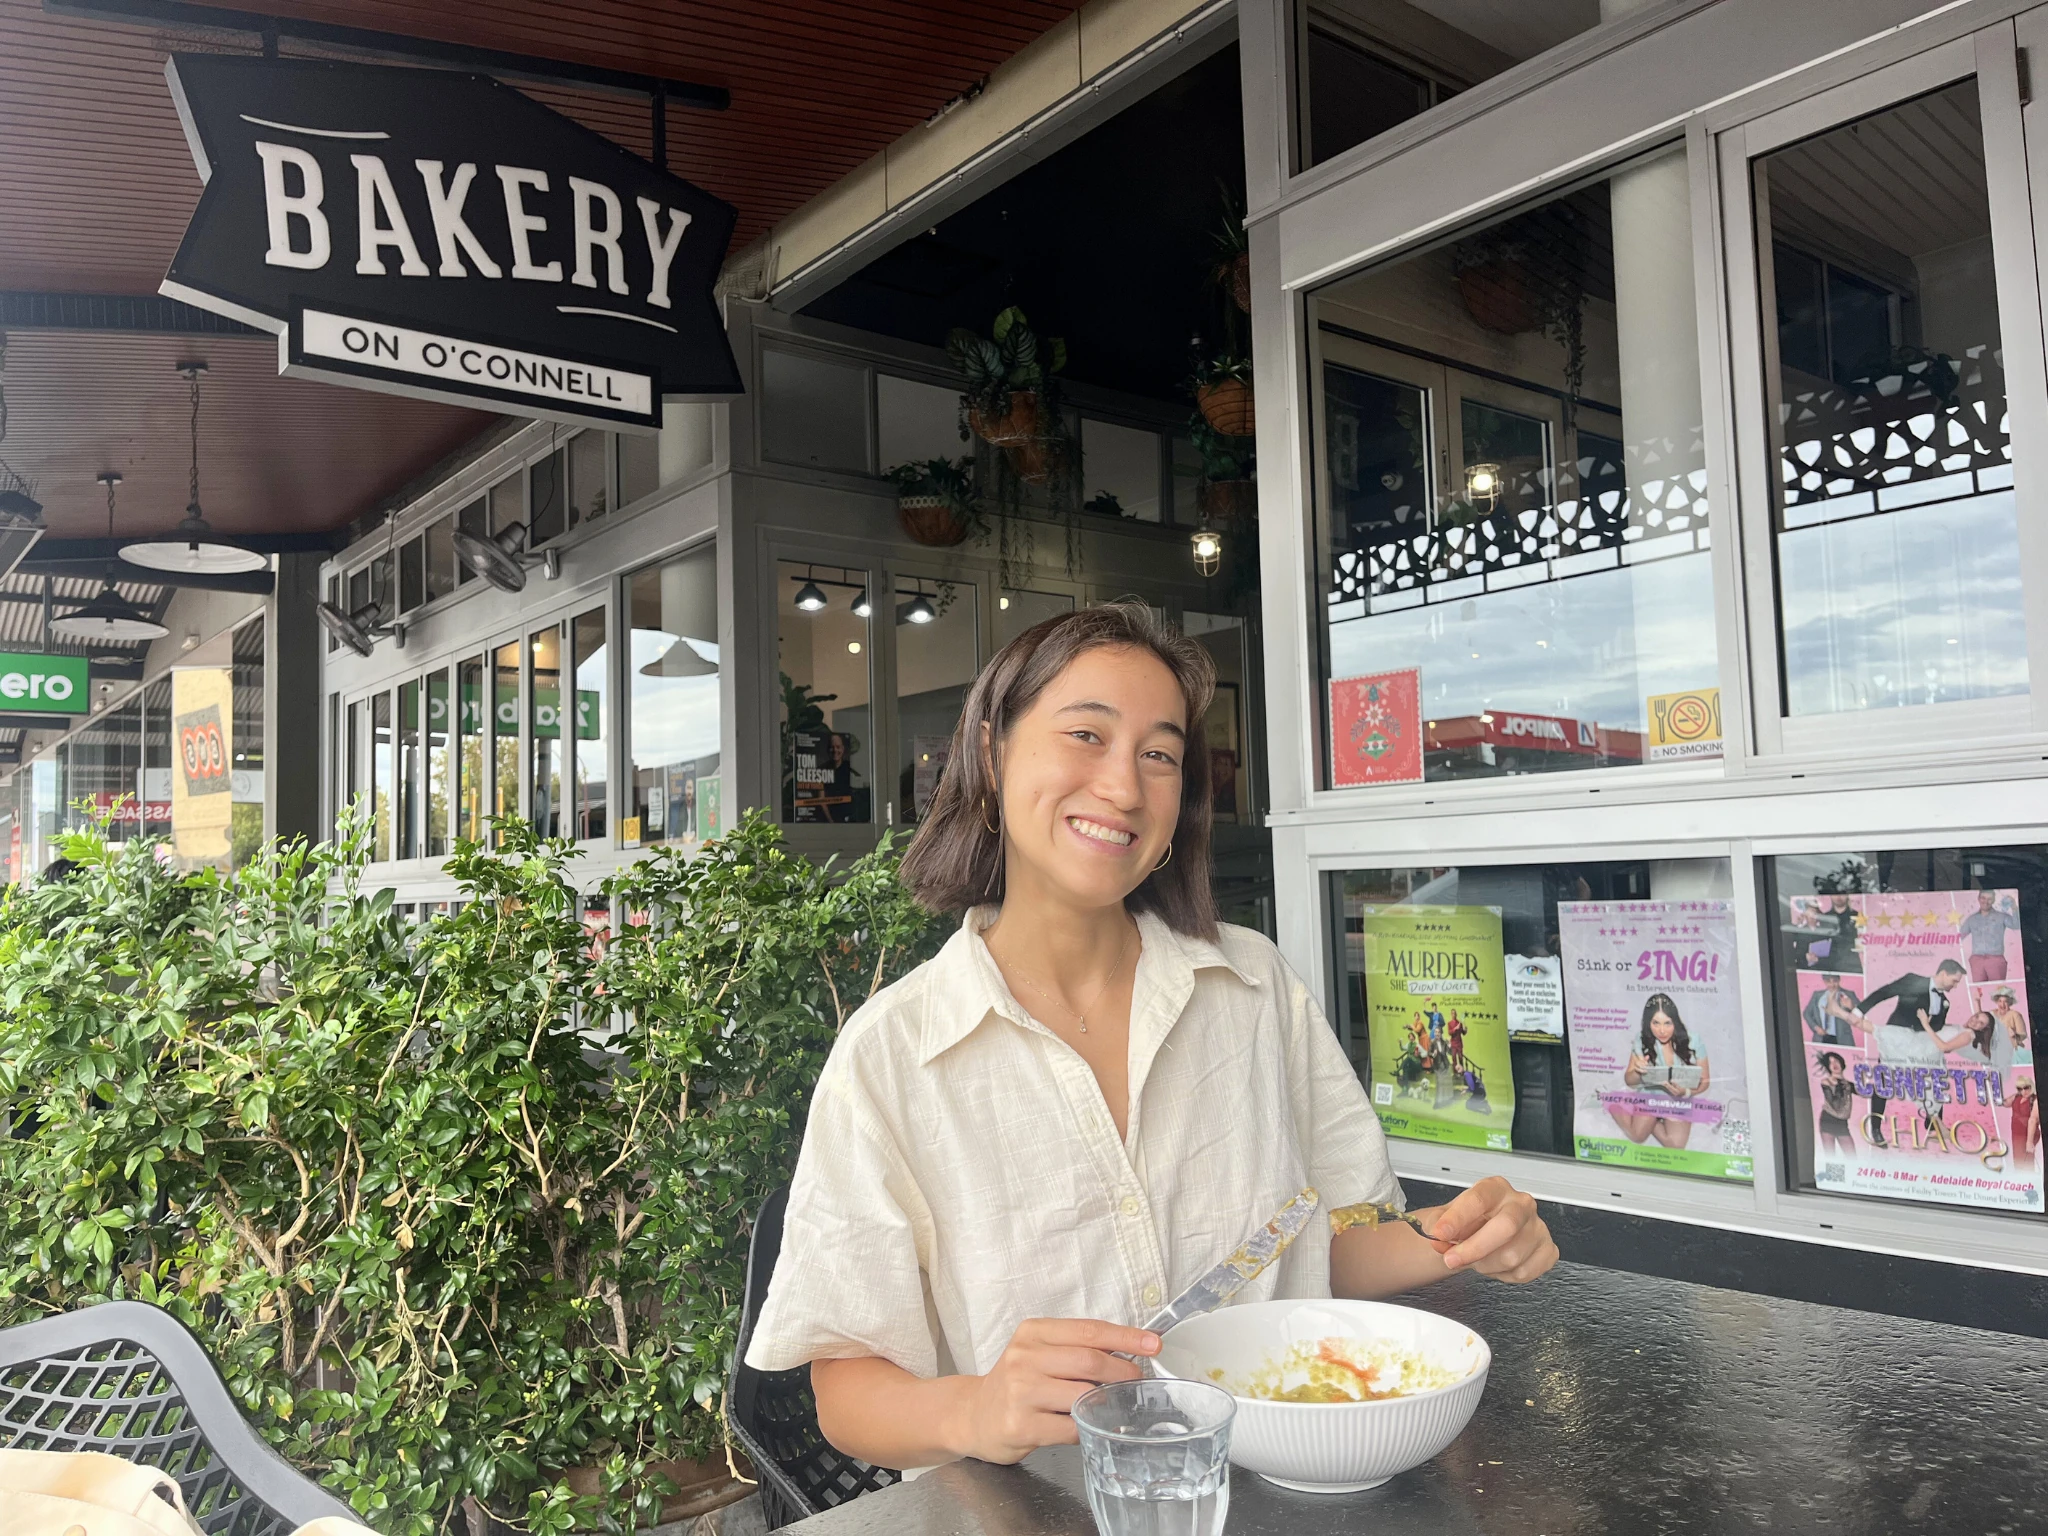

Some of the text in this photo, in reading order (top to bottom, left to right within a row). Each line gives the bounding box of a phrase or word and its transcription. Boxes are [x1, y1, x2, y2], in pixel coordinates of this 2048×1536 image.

[255, 140, 692, 309] BAKERY
[342, 327, 622, 402] ON O'CONNELL
[797, 753, 816, 768] TOM
[1662, 747, 1677, 756] NO
[797, 769, 834, 783] GLEESON
[1577, 950, 1719, 982] Sink or SING!
[1390, 979, 1407, 991] SHE
[1441, 980, 1475, 992] WRITE
[1637, 984, 1684, 992] Interactive
[1686, 985, 1718, 993] Cabaret
[1908, 1056, 1941, 1066] Wedding
[1853, 1063, 2004, 1106] CONFETTI
[1624, 1097, 1646, 1105] FROM
[1648, 1099, 1692, 1109] EDINBURGH
[1377, 1112, 1409, 1129] luttony
[1579, 1138, 1627, 1157] Gluttony
[1860, 1112, 2009, 1173] CHAOS
[1857, 1167, 1869, 1177] 24
[1869, 1168, 1886, 1178] Feb
[1893, 1171, 1899, 1180] 8
[1900, 1172, 1919, 1182] Mar
[1930, 1174, 1974, 1187] Adelaide
[1975, 1178, 2003, 1191] Royal
[2003, 1181, 2035, 1192] Coach
[1852, 1180, 1867, 1188] From
[1869, 1182, 1878, 1190] the
[1911, 1186, 1932, 1197] Faulty
[1934, 1188, 1958, 1198] Towers
[1959, 1190, 1972, 1199] The
[1974, 1192, 1998, 1203] Dining
